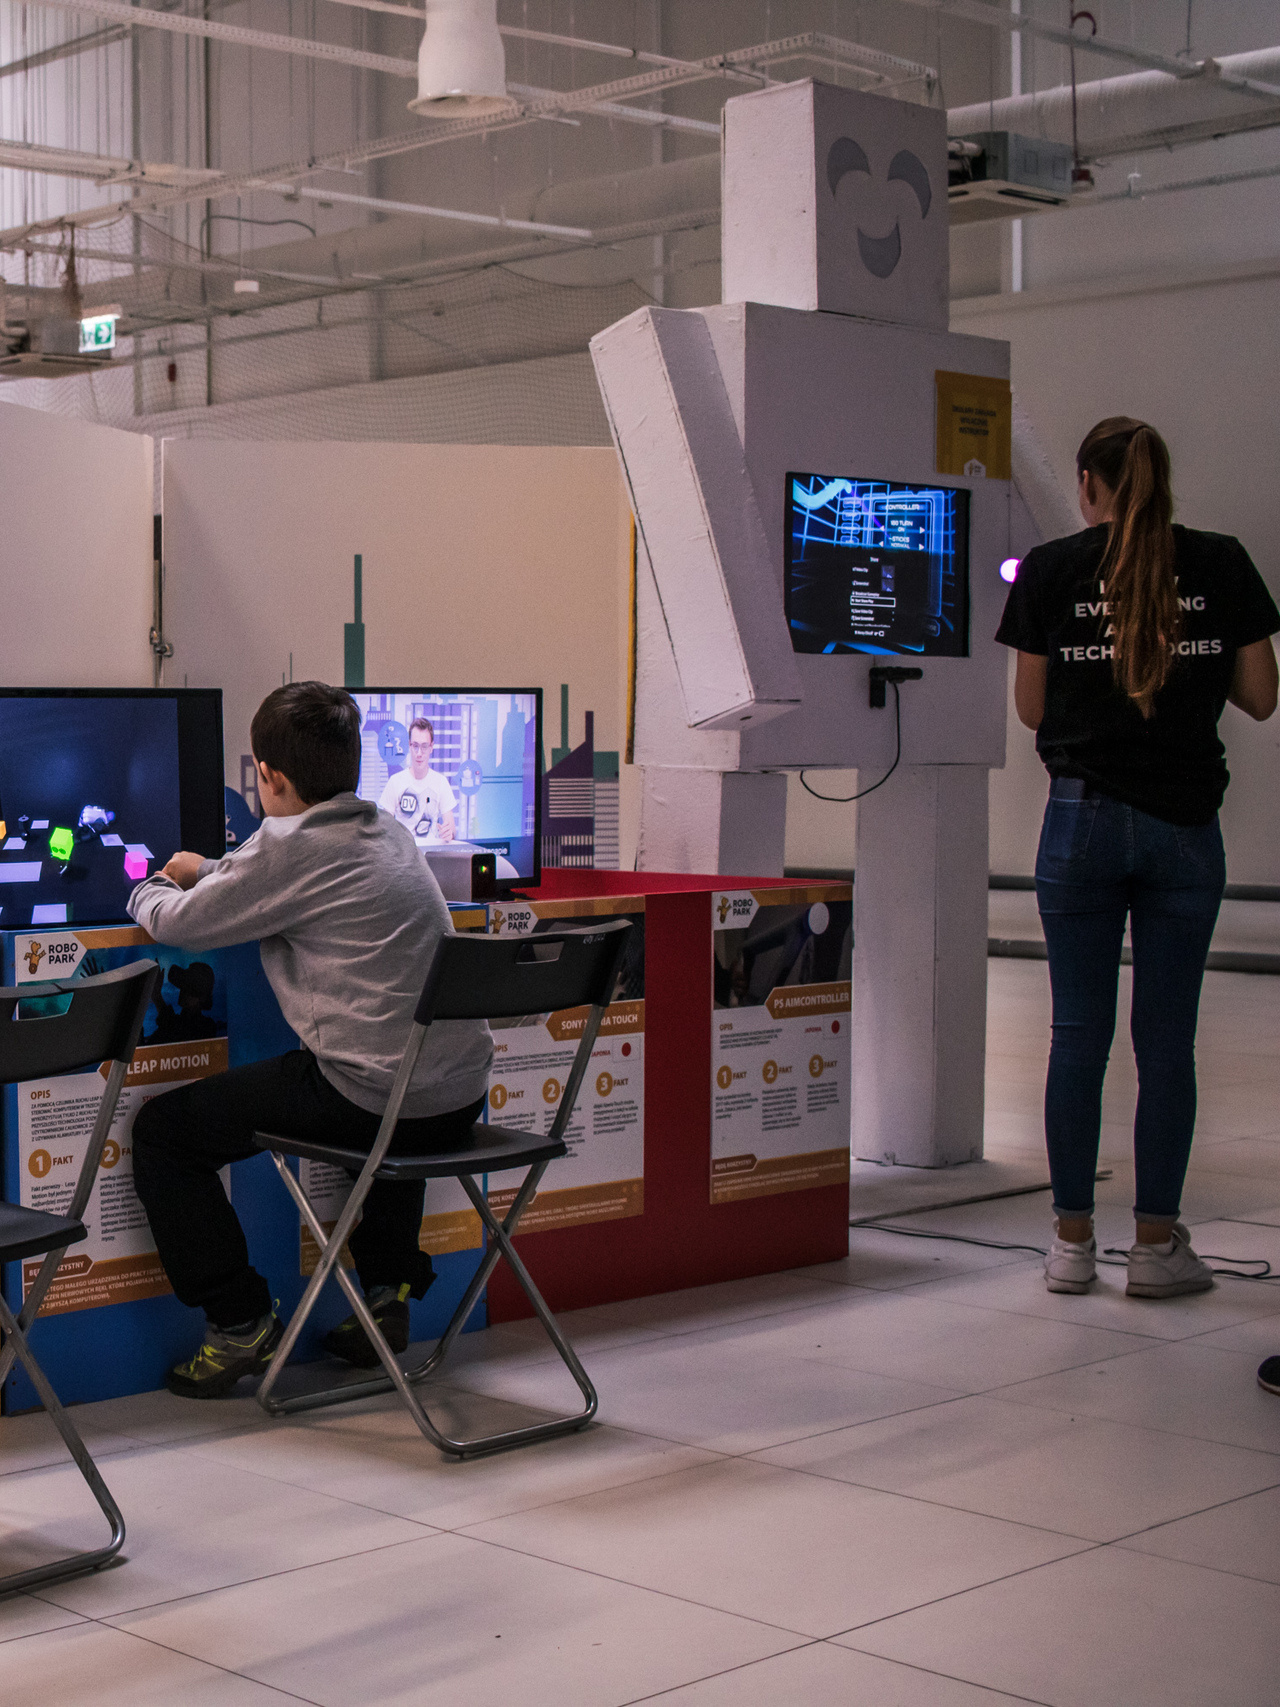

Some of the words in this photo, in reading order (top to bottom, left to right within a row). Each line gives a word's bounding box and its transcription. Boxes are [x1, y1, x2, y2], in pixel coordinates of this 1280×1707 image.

[1060, 639, 1222, 662] TECHGIES
[733, 899, 753, 907] ROBO
[508, 912, 531, 921] ROBO
[733, 907, 751, 916] PARK
[508, 920, 529, 930] PARK
[48, 943, 78, 955] ROBO
[48, 953, 76, 965] PARK
[774, 998, 784, 1009] PS
[785, 992, 850, 1008] AIMCONTROLLER
[561, 1019, 583, 1030] SONY
[612, 1014, 638, 1025] TOUCH
[127, 1060, 157, 1075] LEAP
[160, 1053, 210, 1071] MOTION
[824, 1060, 838, 1068] FAKT
[778, 1065, 793, 1074] FAKT
[732, 1071, 747, 1080] FAKT
[613, 1078, 629, 1087] FAKT
[30, 1089, 51, 1100] OPIS
[508, 1090, 525, 1099] FAKT
[104, 1145, 115, 1162] 2
[121, 1147, 132, 1156] FA
[52, 1155, 74, 1166] FAKT
